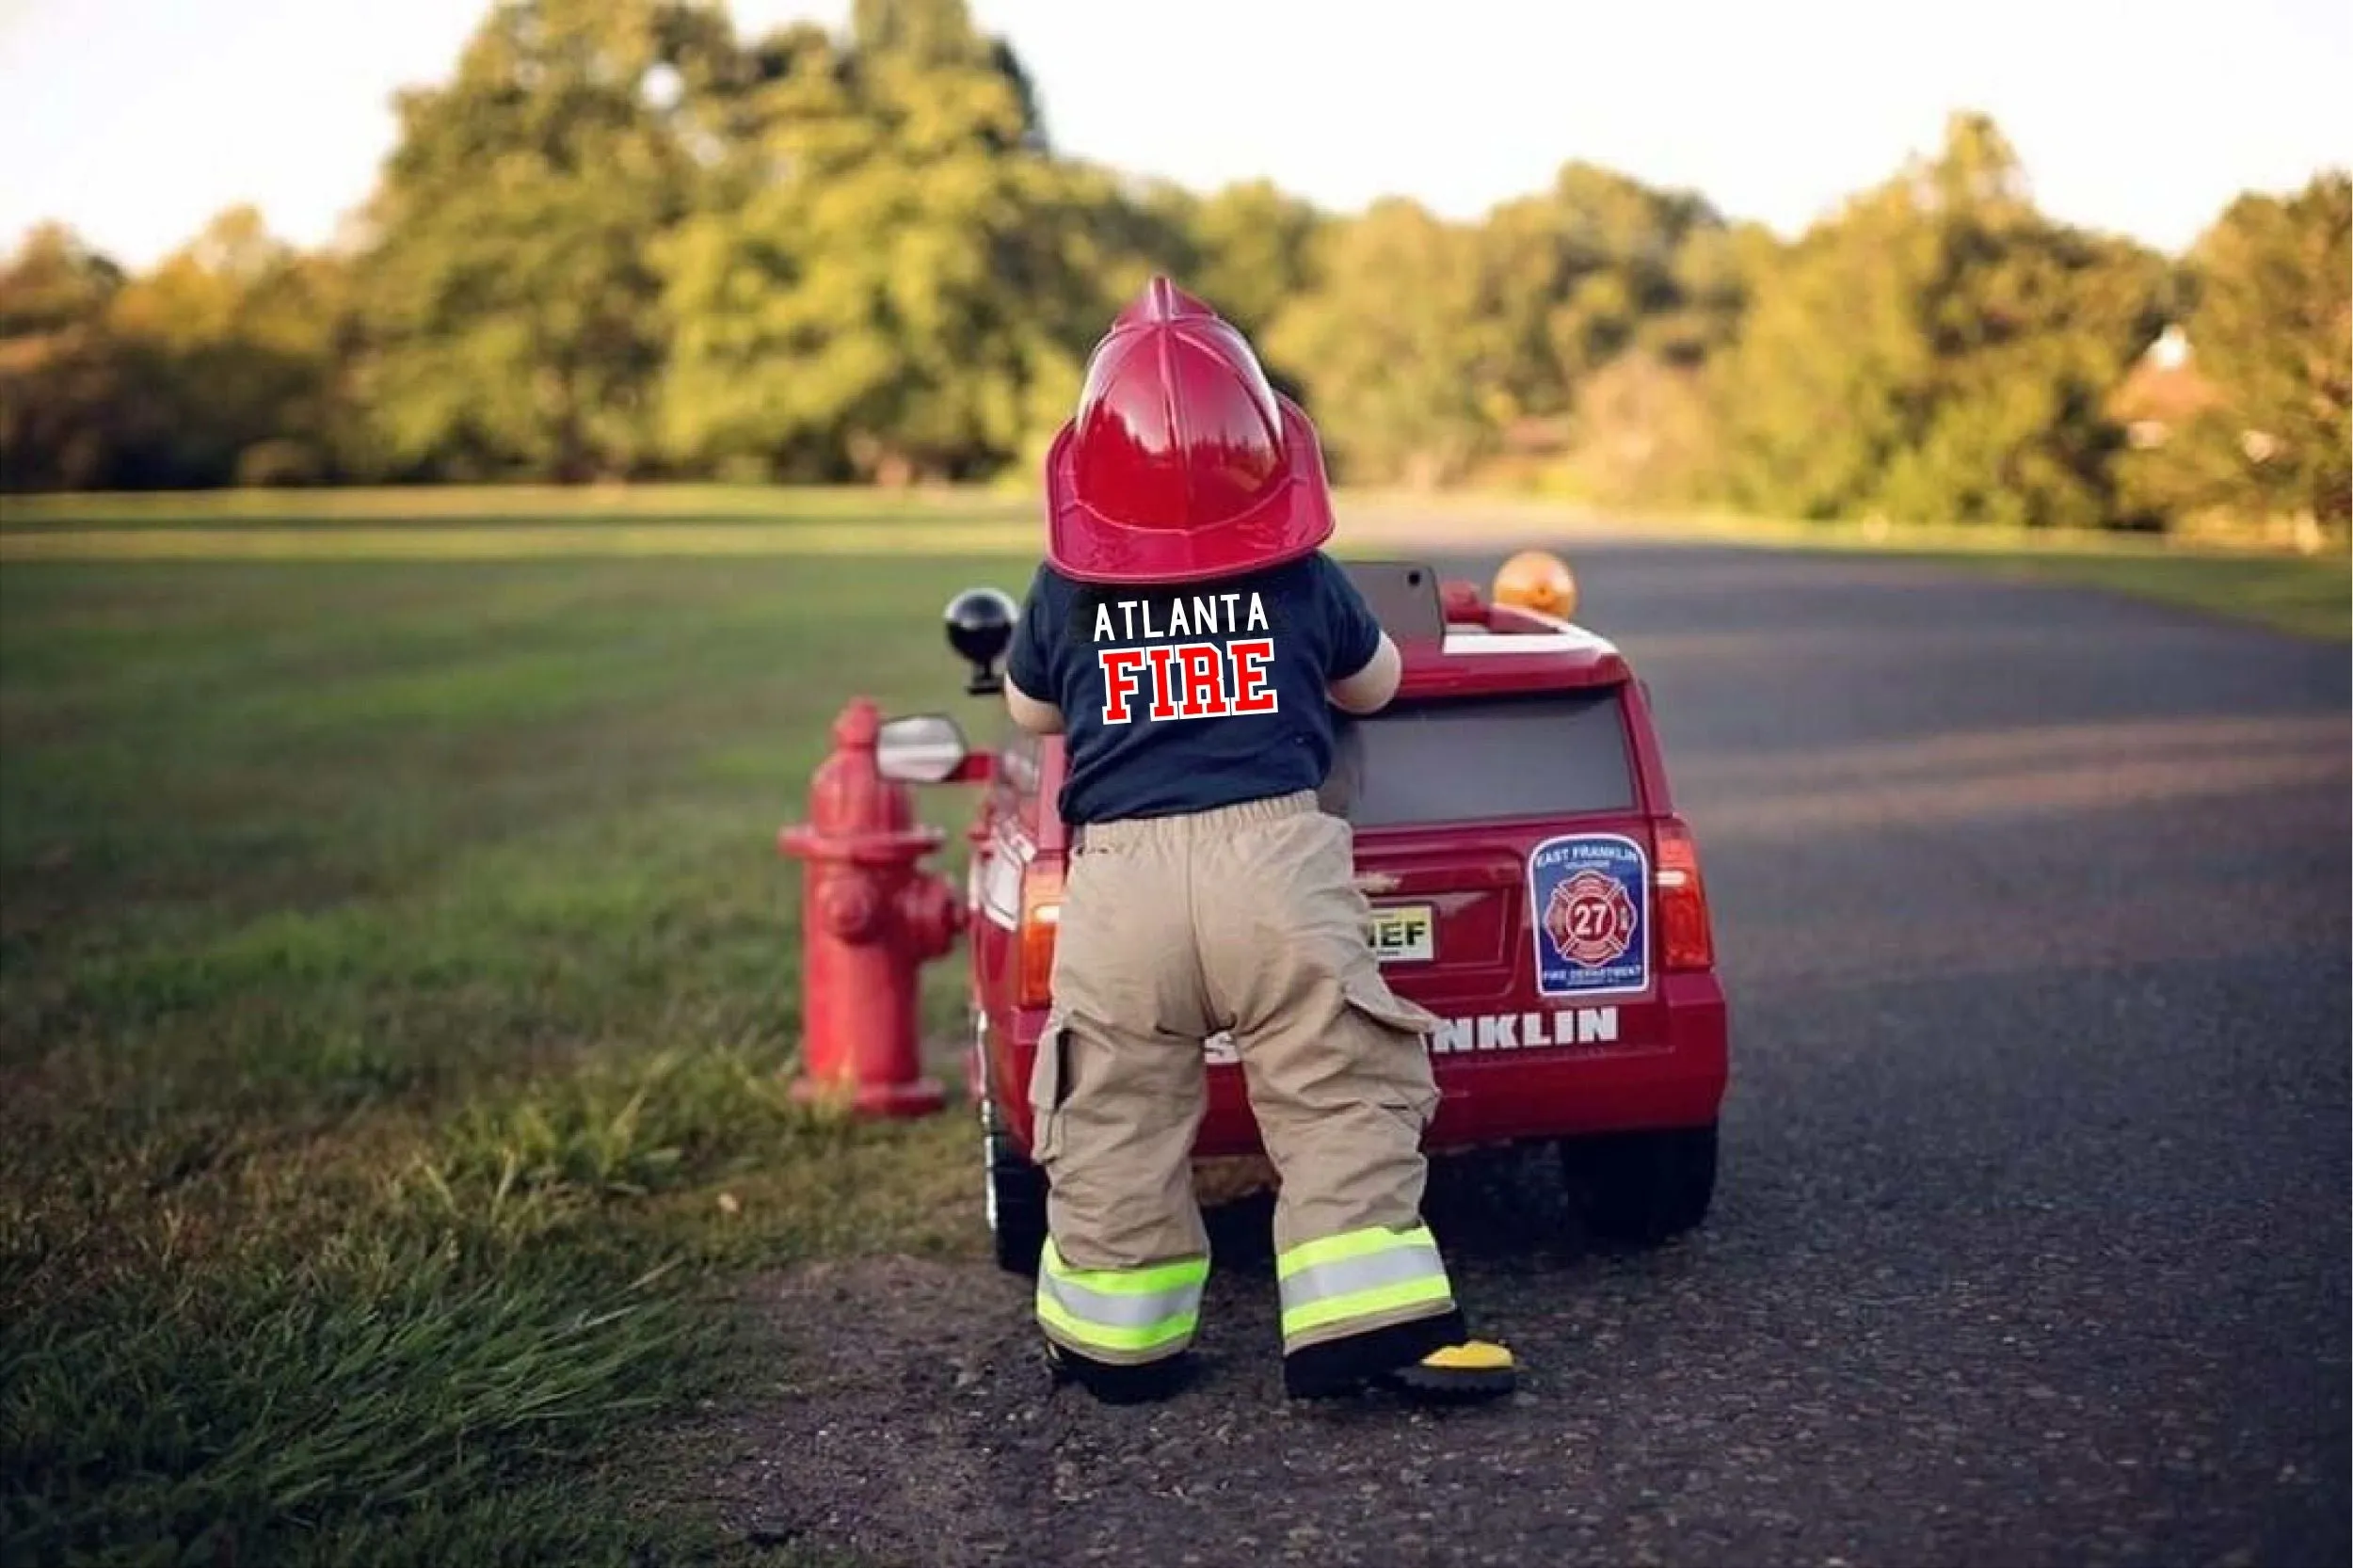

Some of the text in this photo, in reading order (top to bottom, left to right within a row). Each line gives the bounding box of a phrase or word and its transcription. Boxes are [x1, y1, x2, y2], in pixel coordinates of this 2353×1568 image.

[1094, 592, 1269, 642] ATLANTA
[1097, 637, 1278, 725] FIRE
[1574, 904, 1608, 936] 27
